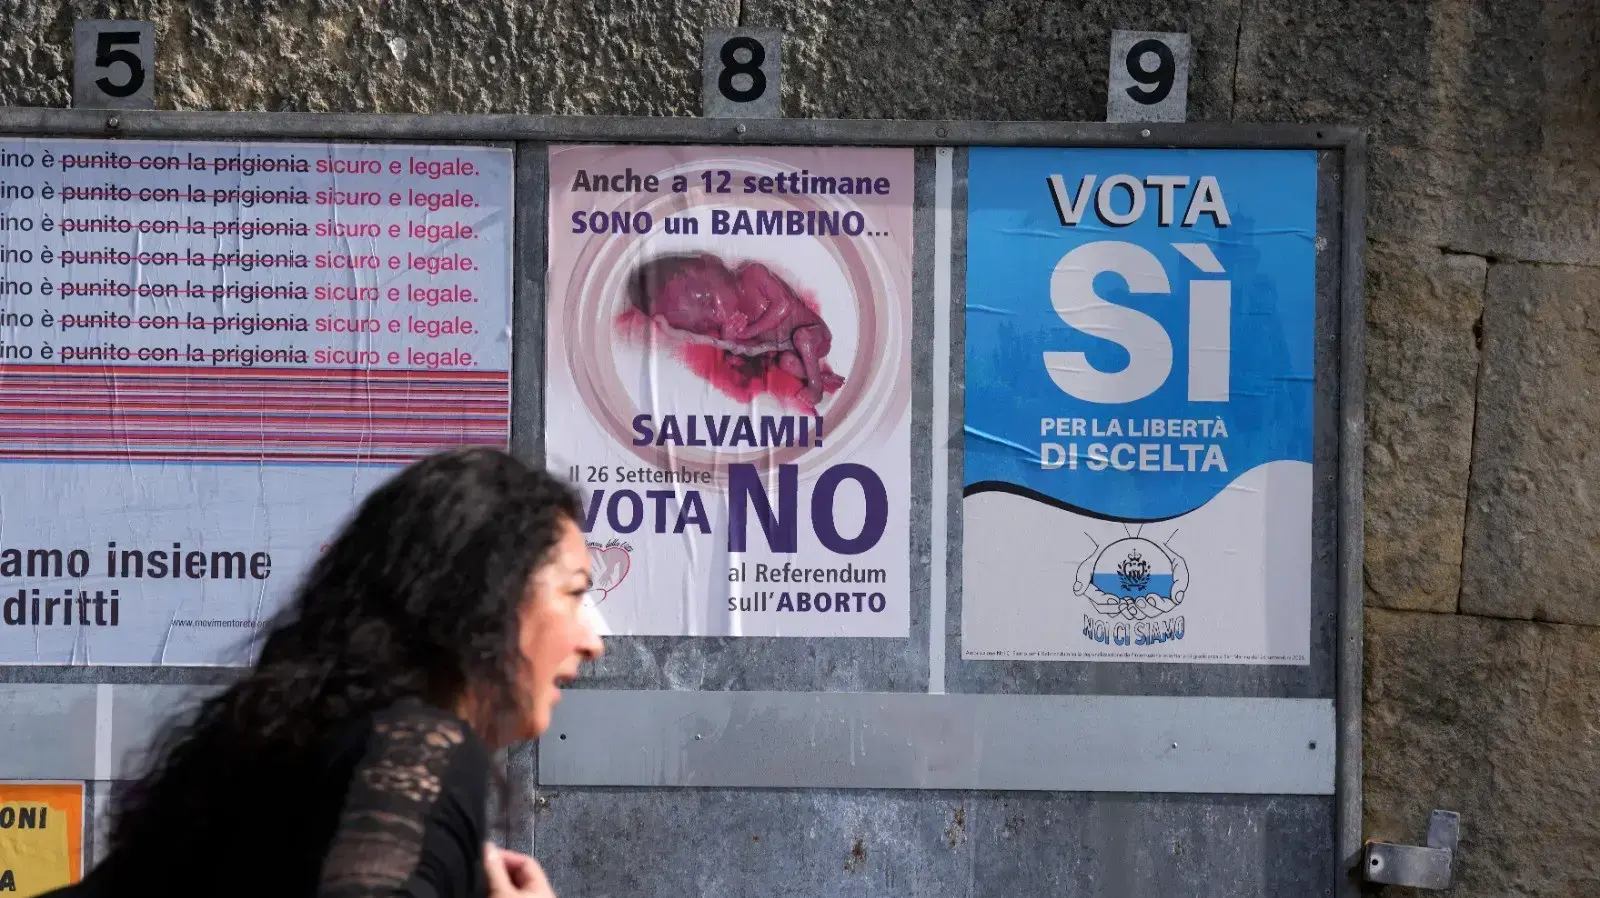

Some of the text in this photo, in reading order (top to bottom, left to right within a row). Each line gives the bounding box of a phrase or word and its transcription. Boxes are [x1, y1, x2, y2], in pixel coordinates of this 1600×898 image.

[95, 31, 145, 97] 5
[718, 36, 767, 103] 8
[1125, 38, 1175, 105] 9
[42, 150, 54, 168] è
[61, 152, 132, 172] punito
[138, 156, 181, 170] con
[187, 153, 206, 171] la
[214, 153, 309, 176] prigionia
[316, 156, 382, 174] sicuro
[388, 161, 402, 174] e
[409, 157, 480, 179] legale.
[571, 168, 890, 195] Anche a 12 settimane
[42, 182, 54, 200] è
[61, 184, 132, 204] punito
[138, 188, 181, 202] con
[187, 185, 206, 203] la
[214, 185, 309, 208] prigionia
[316, 188, 382, 206] sicuro
[388, 193, 402, 206] e
[409, 189, 480, 211] legale.
[1046, 174, 1231, 228] VOTA
[42, 214, 54, 232] è
[61, 216, 132, 236] punito
[138, 220, 181, 234] con
[187, 217, 206, 235] la
[214, 217, 309, 240] prigionia
[316, 220, 382, 238] sicuro
[388, 225, 402, 238] e
[409, 221, 480, 243] legale.
[571, 211, 653, 235] SONO
[664, 217, 698, 235] un
[41, 246, 53, 264] è
[60, 248, 131, 268] punito
[137, 252, 180, 266] con
[186, 249, 205, 267] la
[213, 249, 308, 272] prigionia
[315, 252, 381, 270] sicuro
[387, 257, 401, 270] e
[408, 253, 479, 275] legale.
[41, 277, 53, 295] è
[60, 279, 131, 299] punito
[137, 283, 180, 297] con
[186, 280, 205, 298] la
[213, 280, 308, 303] prigionia
[315, 283, 381, 301] sicuro
[387, 288, 401, 301] e
[408, 284, 479, 306] legale.
[41, 310, 53, 328] è
[60, 312, 131, 332] punito
[137, 316, 180, 330] con
[186, 313, 205, 331] la
[213, 313, 308, 336] prigionia
[315, 315, 381, 333] sicuro
[387, 320, 401, 333] e
[408, 316, 479, 338] legale.
[41, 342, 53, 360] è
[60, 344, 131, 364] punito
[137, 348, 180, 362] con
[186, 345, 205, 363] la
[213, 345, 308, 368] prigionia
[315, 346, 381, 364] sicuro
[387, 351, 401, 364] e
[408, 347, 479, 369] legale.
[632, 414, 824, 448] SALVAMI!
[1040, 415, 1228, 438] PER LA LIBERTÀ
[1040, 442, 1228, 472] DI SCELTA
[587, 466, 609, 483] 26
[616, 465, 712, 483] Settembre
[727, 463, 889, 555] NO
[0, 541, 271, 579] amo insieme
[728, 563, 887, 583] al Referendum
[3, 589, 119, 626] diritti
[728, 592, 887, 613] sull'ABORTO
[1113, 622, 1131, 646] CI
[1134, 615, 1185, 646] SIAMO
[0, 807, 47, 829] ONI
